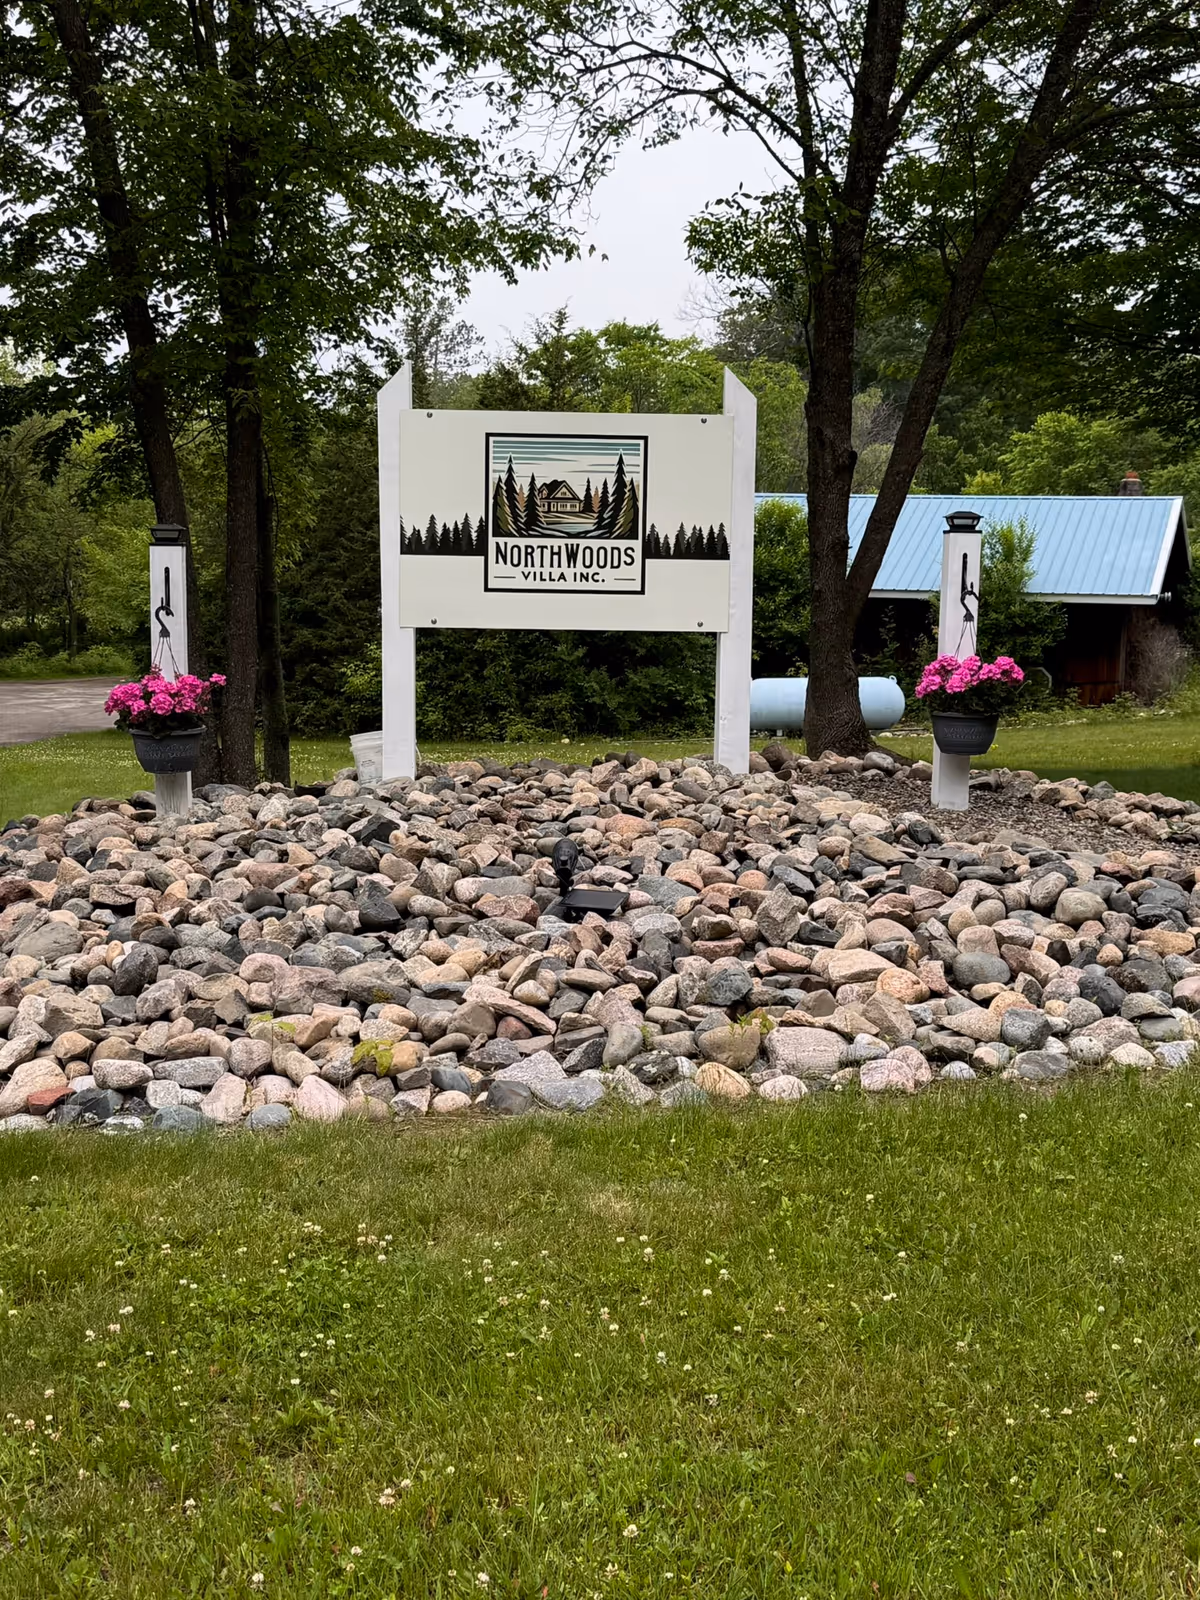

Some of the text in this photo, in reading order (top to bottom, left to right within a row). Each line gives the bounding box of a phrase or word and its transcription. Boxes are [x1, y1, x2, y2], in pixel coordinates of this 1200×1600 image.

[495, 541, 635, 569] NORTHWOODS
[521, 571, 606, 583] VILLA INC.
